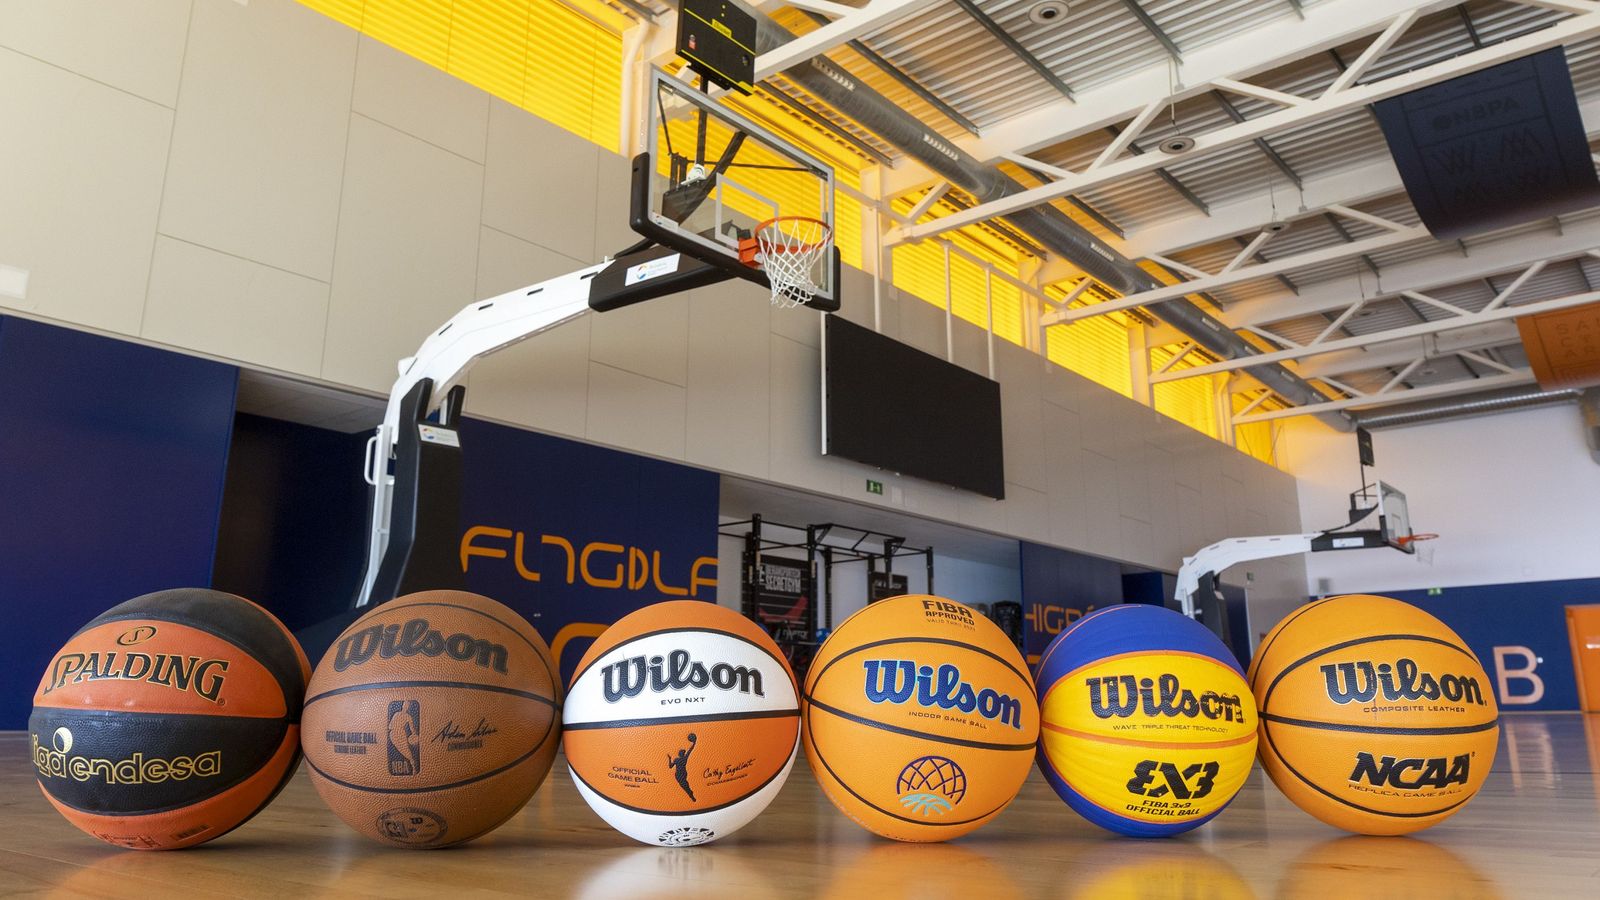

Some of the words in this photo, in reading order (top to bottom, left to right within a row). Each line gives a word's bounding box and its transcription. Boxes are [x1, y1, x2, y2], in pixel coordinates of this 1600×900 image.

[922, 600, 973, 619] FIBA
[925, 611, 975, 626] APPROVED
[333, 618, 509, 675] Wilson
[43, 652, 230, 704] SPALDING
[600, 649, 766, 704] Wilson
[1319, 658, 1485, 706] Wilson
[1493, 645, 1545, 705] B
[660, 698, 682, 706] EVO
[863, 659, 1022, 730] Wilson
[1085, 673, 1245, 724] Wilson
[908, 711, 941, 719] INDOOR
[944, 715, 967, 724] GAME
[969, 720, 988, 730] BALL
[68, 751, 222, 784] endesa
[608, 772, 633, 782] GAME
[634, 776, 660, 784] BALL
[612, 766, 652, 776] OFFICIAL
[1348, 751, 1470, 790] NCAA
[1348, 784, 1400, 797] REPLICA
[1126, 804, 1175, 816] OFFICIAL
[1177, 808, 1201, 816] BALL
[1143, 800, 1169, 808] FIBA
